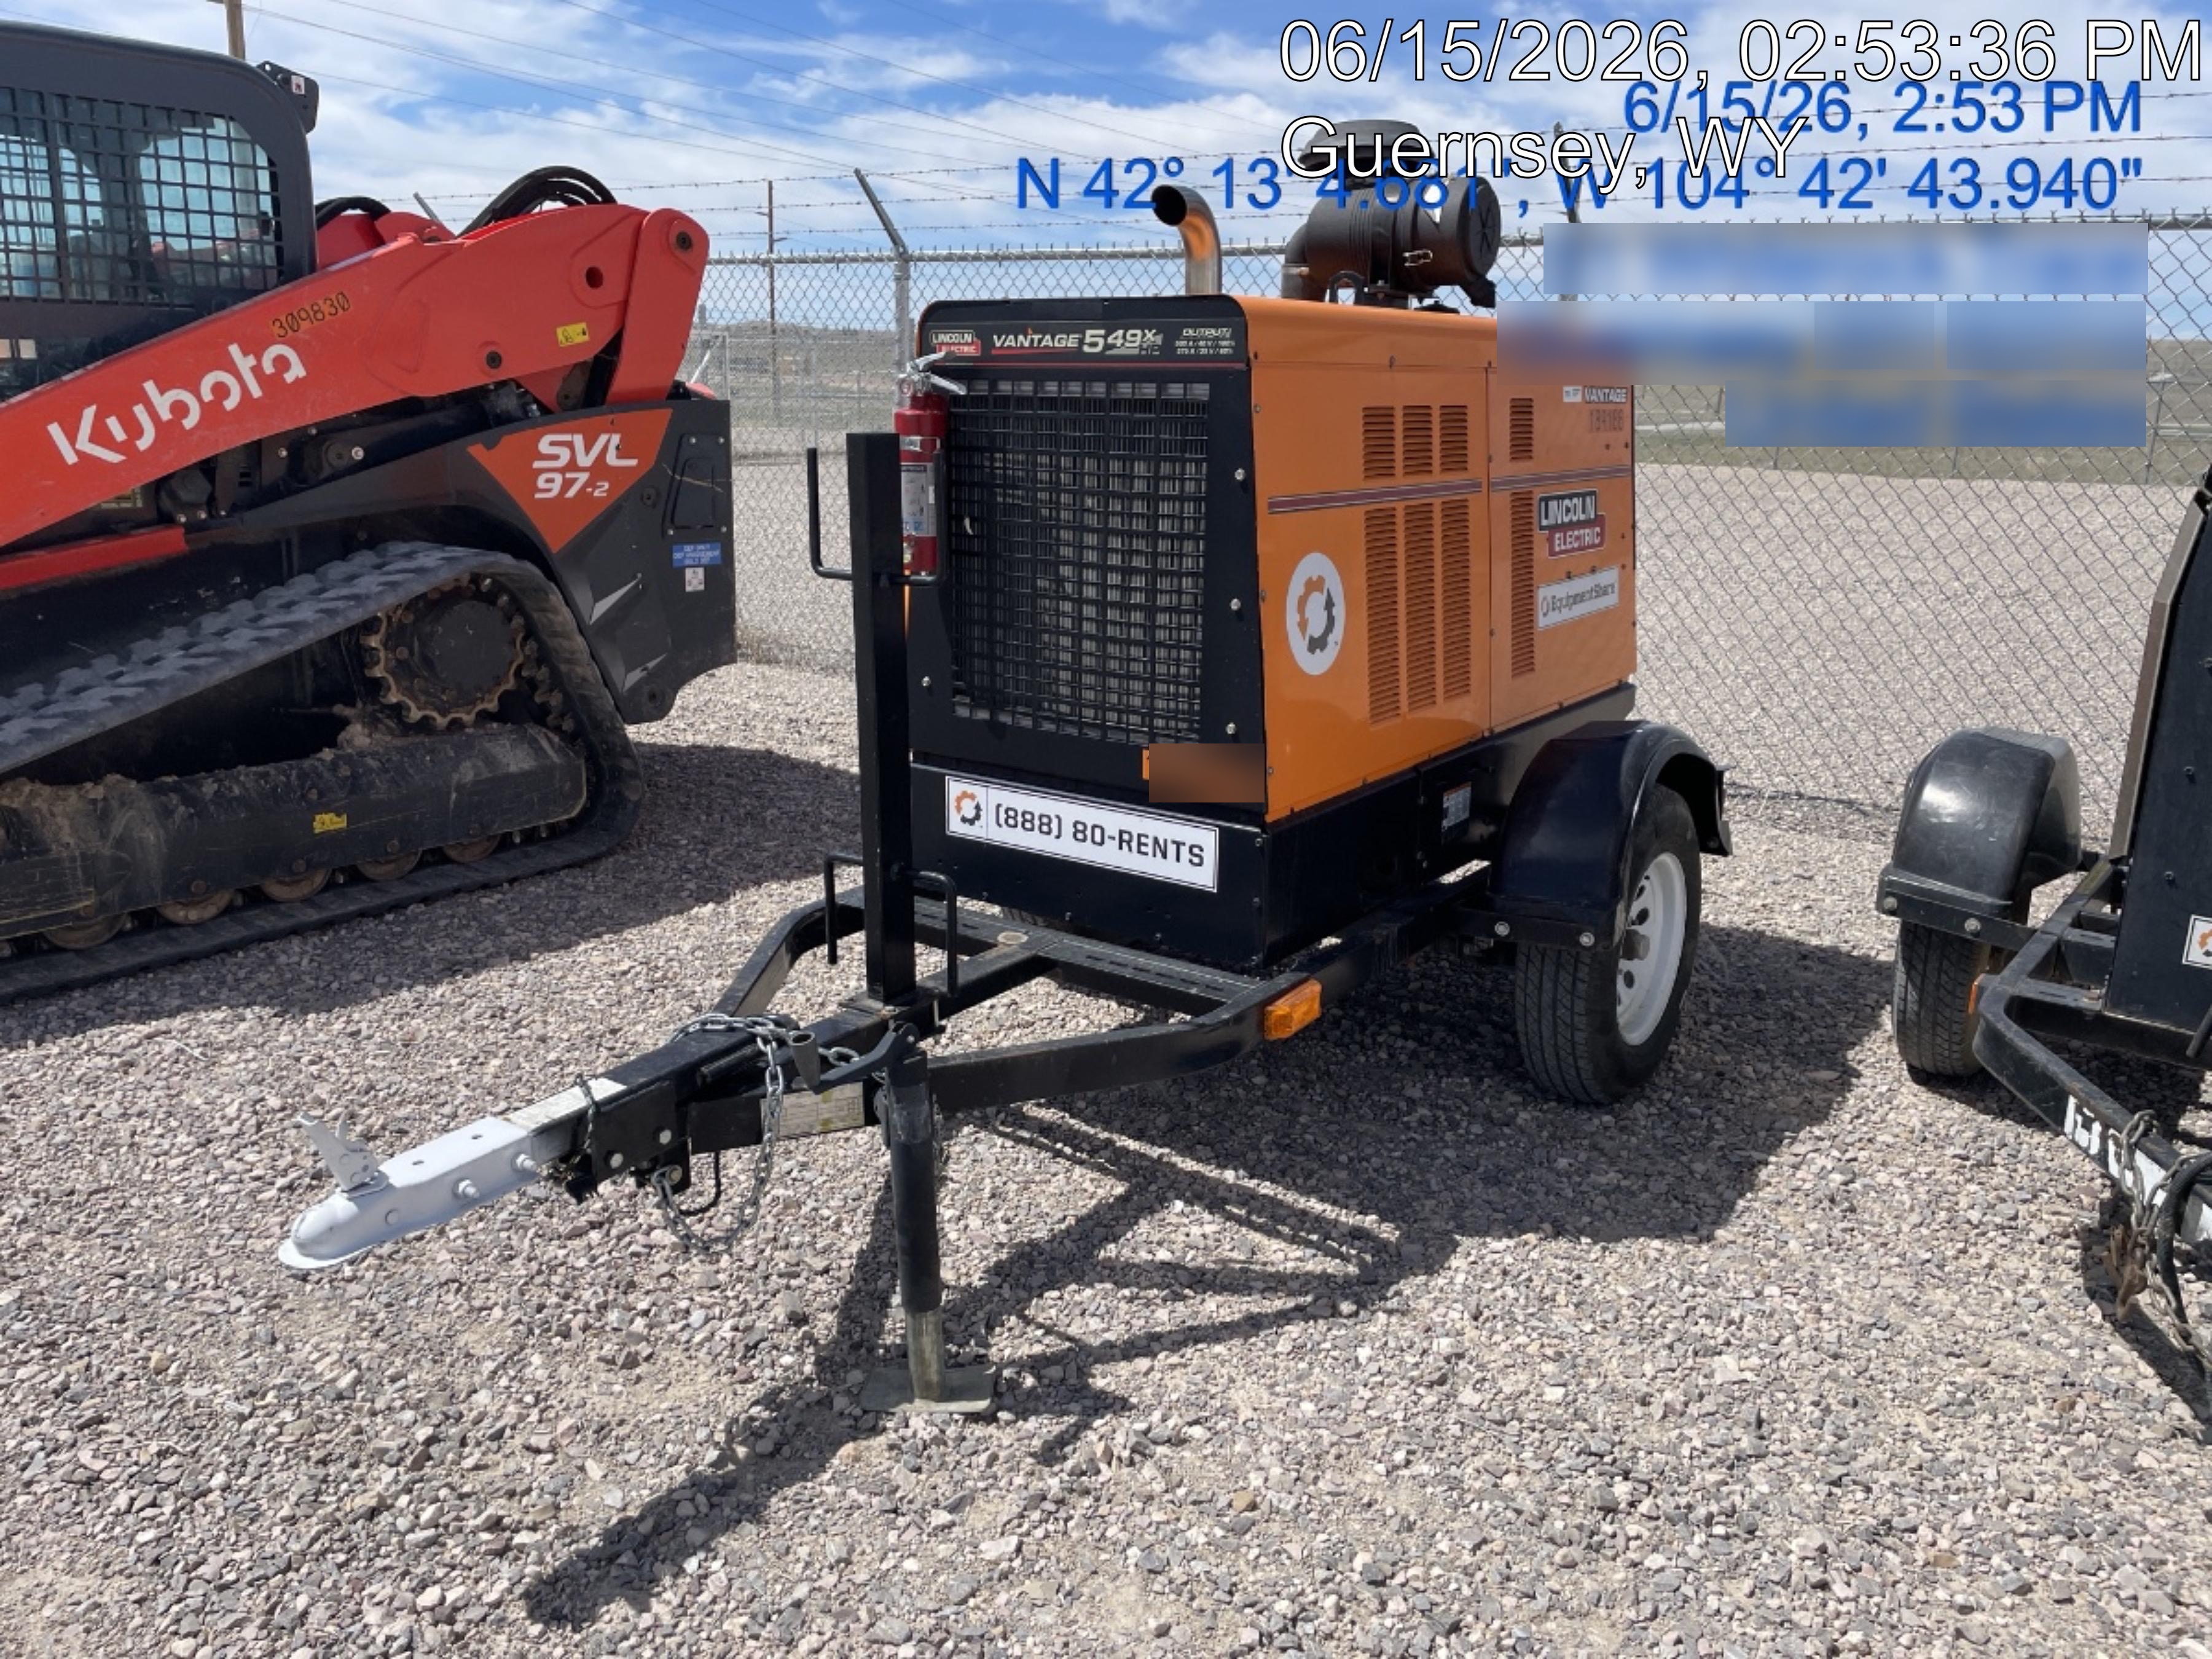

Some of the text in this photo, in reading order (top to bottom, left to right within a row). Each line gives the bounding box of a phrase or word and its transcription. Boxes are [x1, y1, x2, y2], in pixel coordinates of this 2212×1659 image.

[272, 291, 351, 338] 309830
[932, 332, 973, 345] LINCOLN
[993, 334, 1080, 348] VANTAGE
[47, 342, 307, 466] Kubota
[1585, 387, 1627, 403] VANTAGE
[532, 433, 639, 469] SVL
[536, 471, 610, 499] 97-2
[1540, 495, 1595, 527] LINCOLN
[1554, 527, 1601, 552] ELECTRIC
[994, 802, 1205, 868] (888) 80-RENTS
